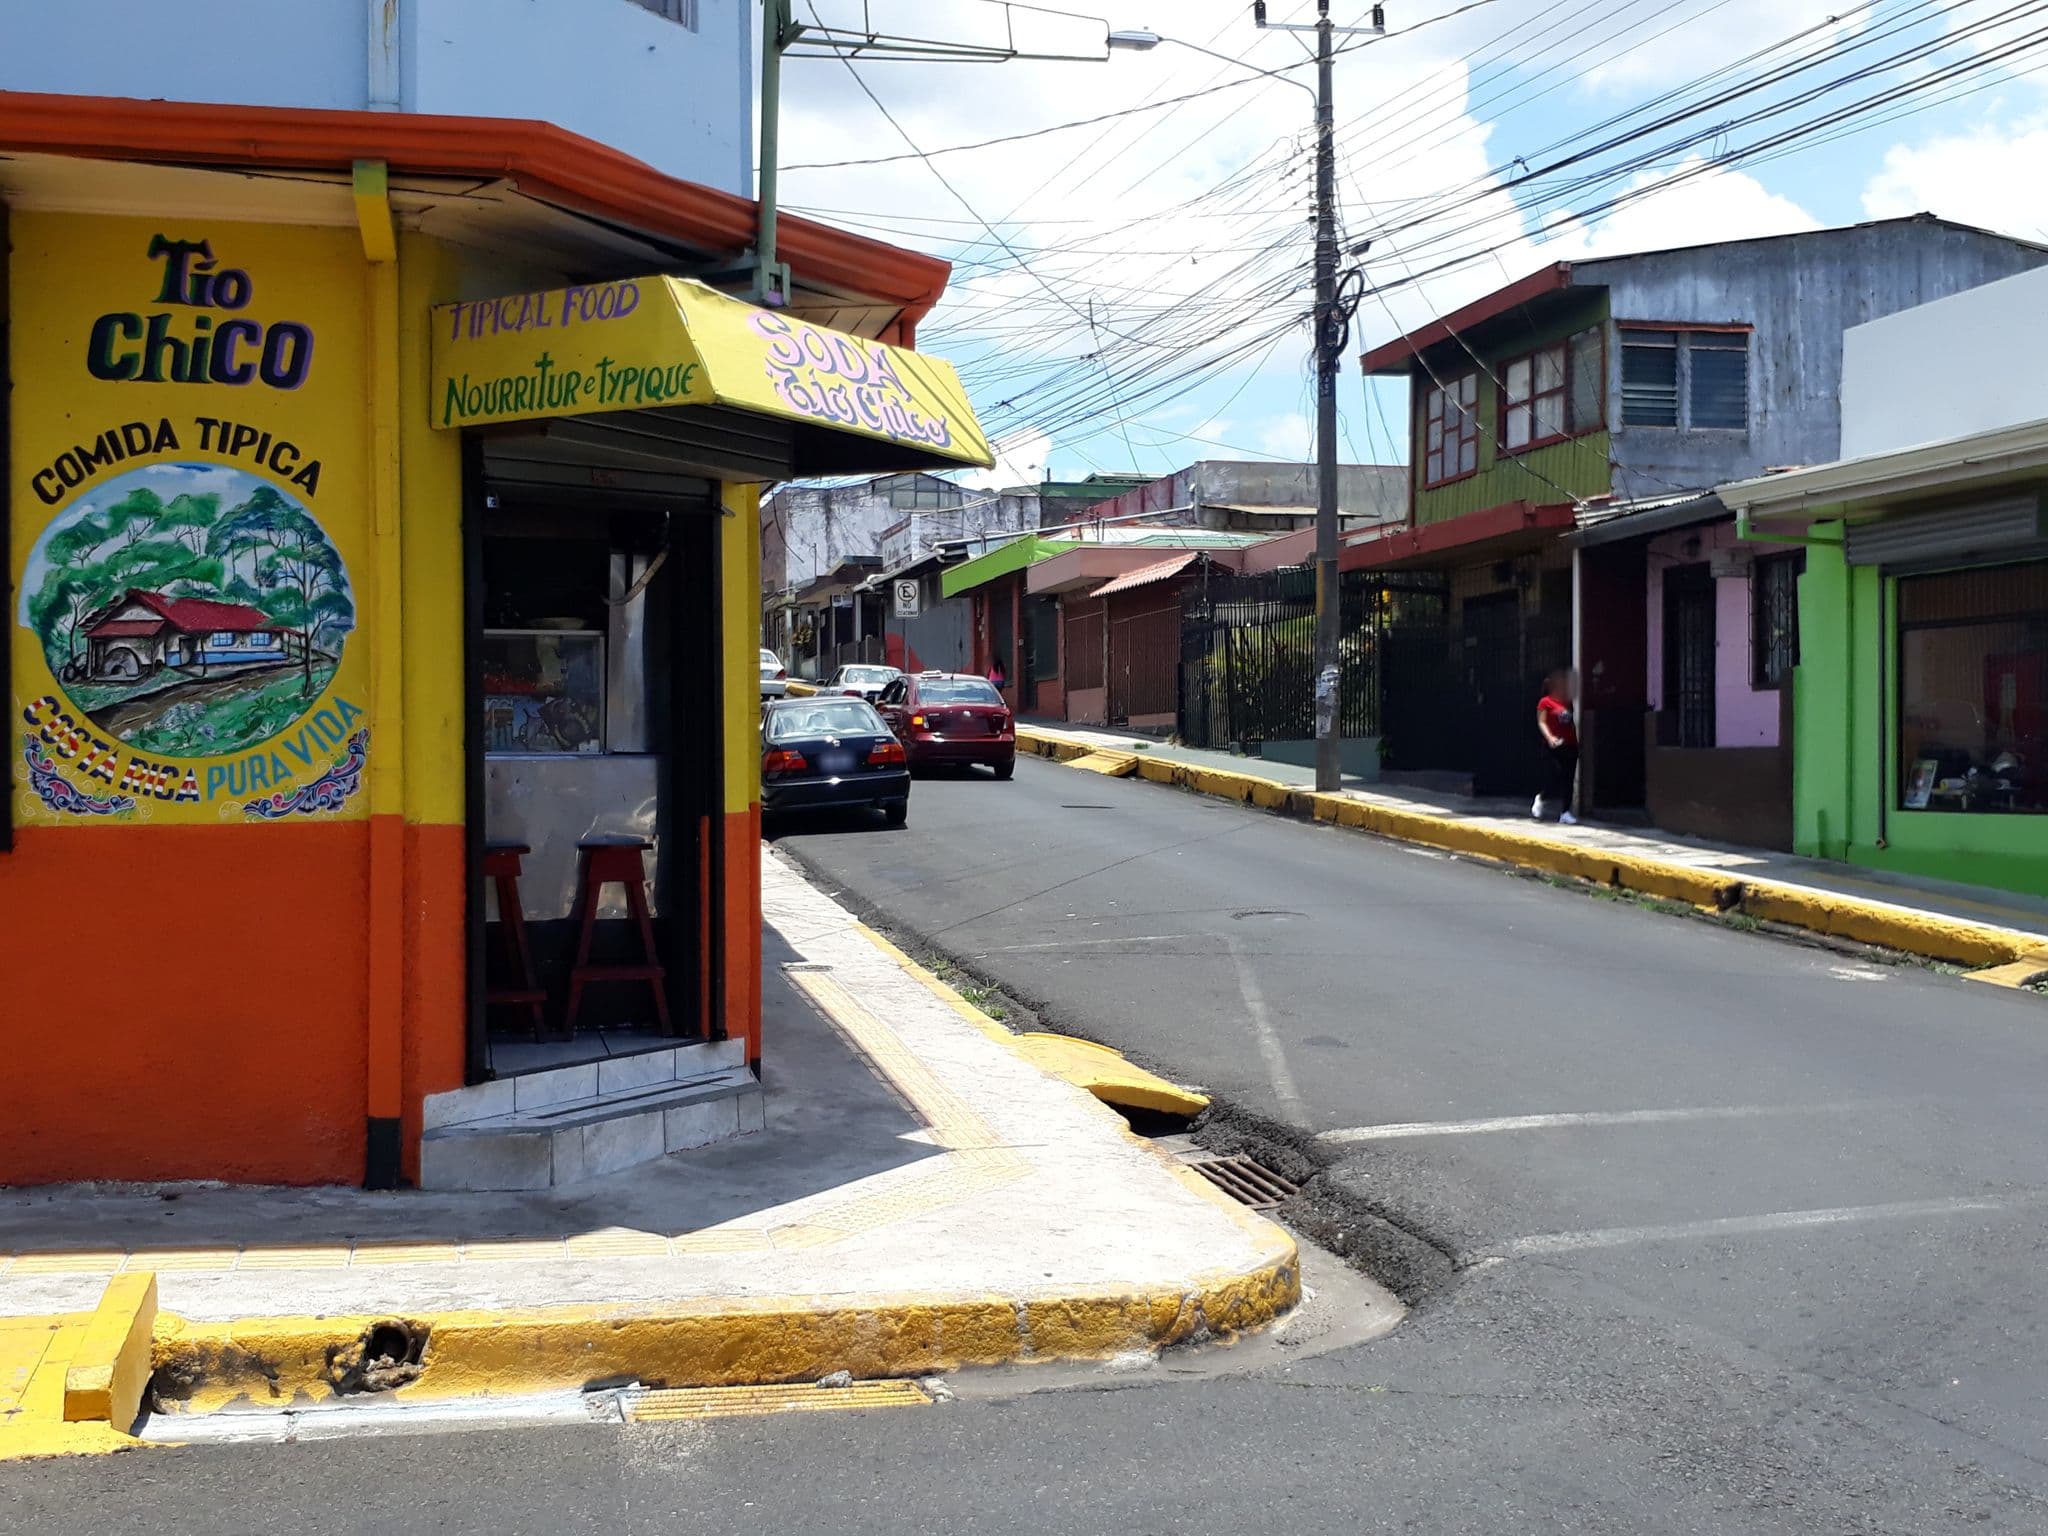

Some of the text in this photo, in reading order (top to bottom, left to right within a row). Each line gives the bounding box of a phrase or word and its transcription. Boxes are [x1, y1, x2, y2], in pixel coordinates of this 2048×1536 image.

[450, 283, 640, 341] TIPICAL FOOD
[749, 311, 913, 401] SODA
[32, 417, 322, 505] COMIDA TIPICA
[24, 695, 200, 802] COSTA RICA
[207, 695, 363, 801] PURA VIDA
